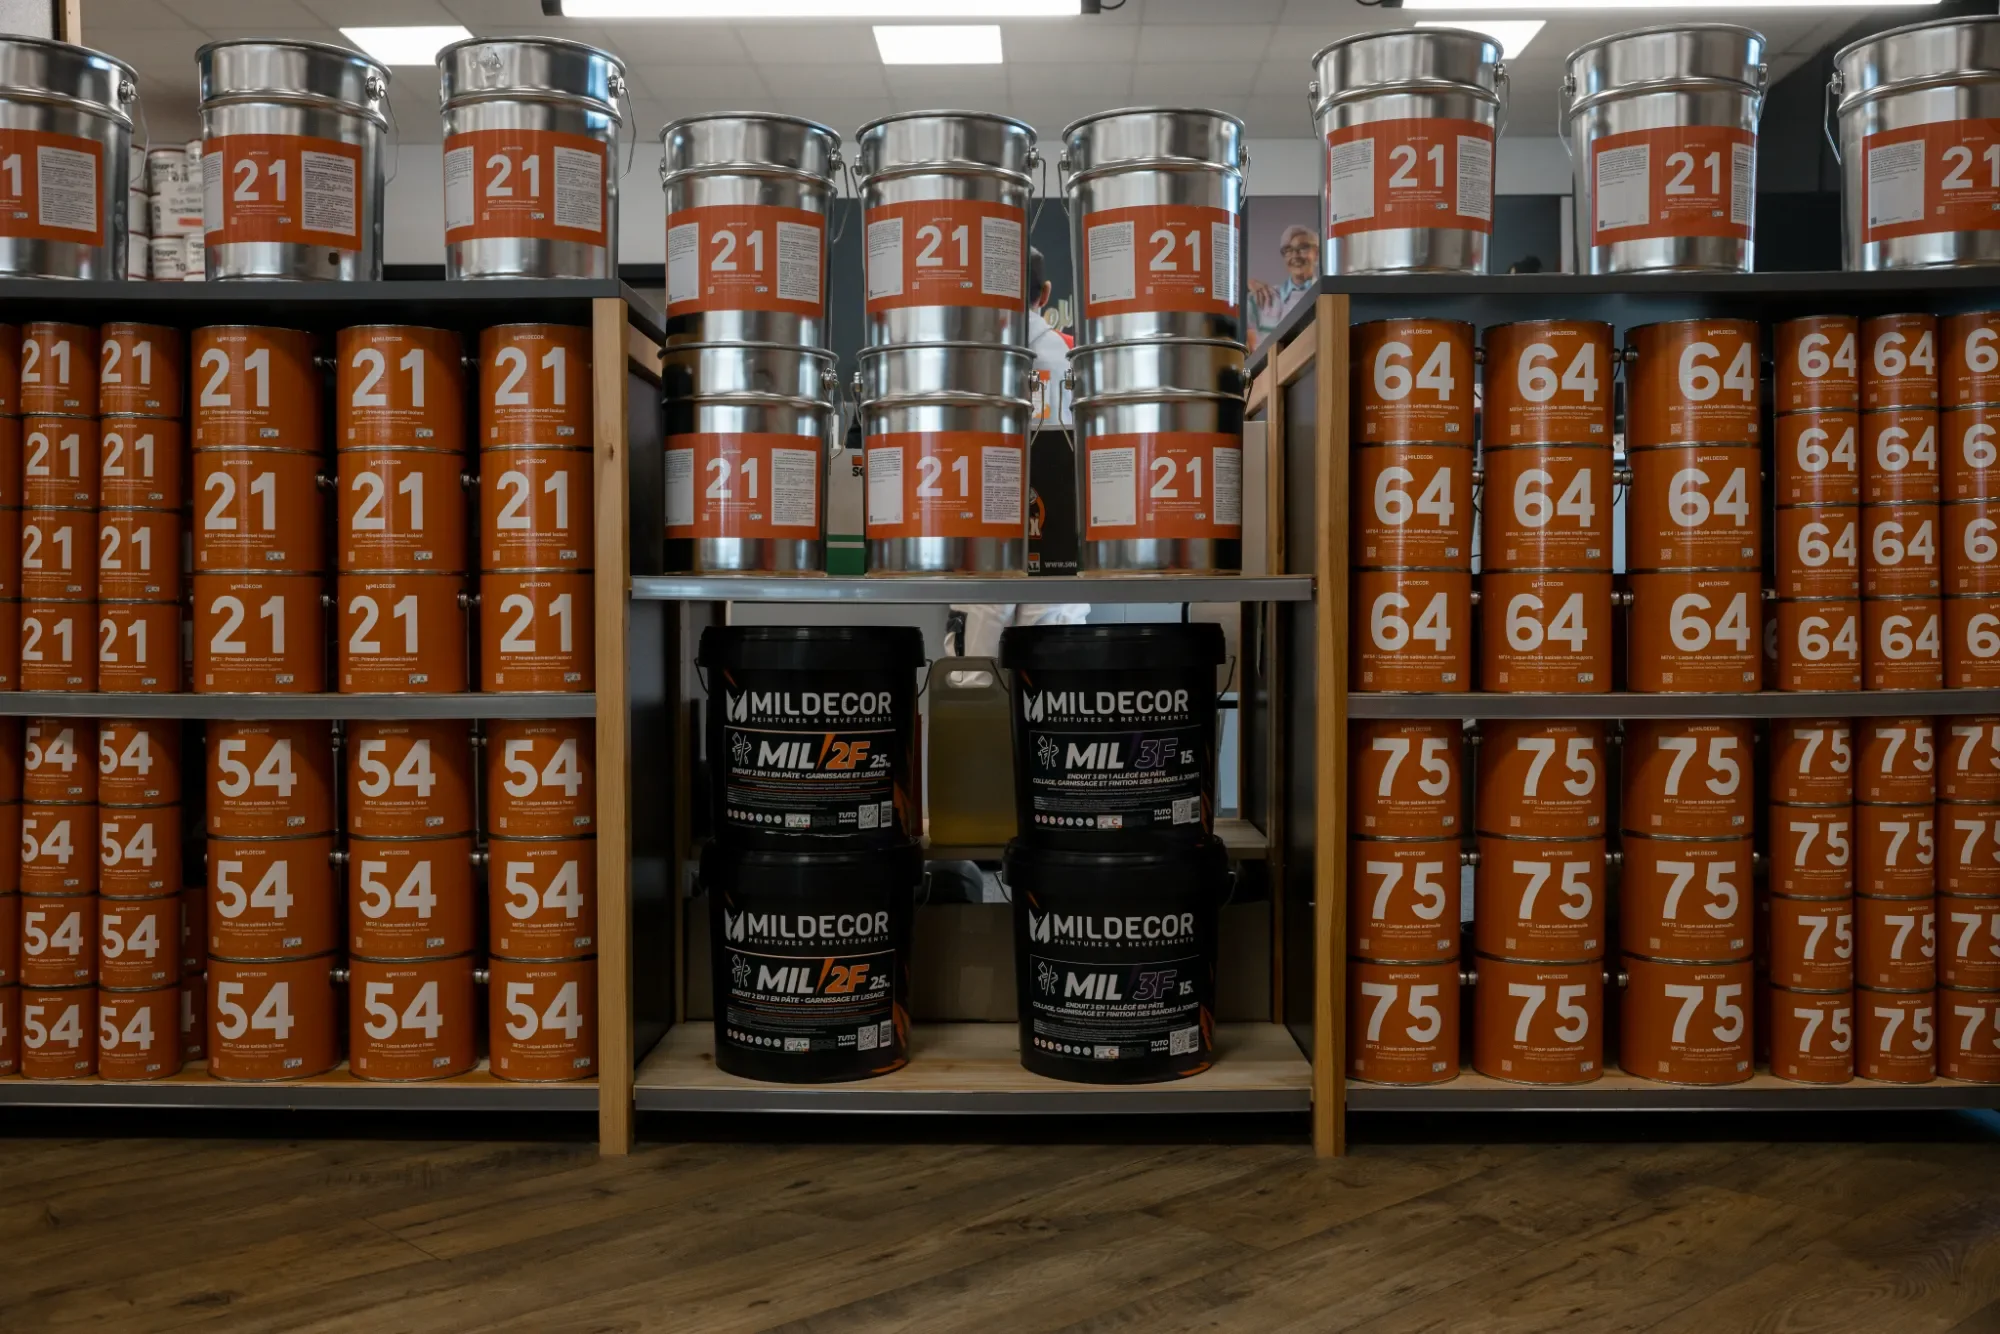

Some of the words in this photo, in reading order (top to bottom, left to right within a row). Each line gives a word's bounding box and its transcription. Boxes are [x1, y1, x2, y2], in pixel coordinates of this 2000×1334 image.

[234, 159, 286, 201] 21
[486, 154, 539, 196] 21
[1389, 144, 1444, 188] 21
[1665, 152, 1720, 195] 21
[1941, 144, 2000, 189] 21
[711, 230, 763, 271] 21
[916, 225, 968, 267] 21
[1149, 229, 1200, 271] 21
[22, 339, 69, 383] 21
[102, 340, 151, 384] 21
[1374, 341, 1454, 401] 64
[1517, 343, 1598, 401] 64
[1678, 342, 1754, 401] 64
[1798, 333, 1856, 378] 64
[1874, 331, 1934, 376] 64
[201, 349, 269, 406] 21
[353, 348, 424, 407] 21
[496, 347, 565, 405] 21
[27, 433, 79, 476] 21
[104, 433, 153, 476] 21
[1797, 428, 1856, 472] 64
[1877, 426, 1936, 471] 64
[705, 457, 758, 498] 21
[916, 456, 968, 496] 21
[1150, 457, 1201, 497] 21
[1374, 467, 1454, 526] 64
[1514, 468, 1595, 527] 64
[1668, 468, 1749, 527] 64
[205, 472, 275, 529] 21
[496, 471, 568, 529] 21
[1873, 520, 1934, 564] 64
[23, 618, 72, 660] 21
[100, 620, 146, 662] 21
[211, 596, 284, 653] 21
[349, 596, 417, 653] 21
[501, 594, 571, 652] 21
[1370, 592, 1451, 651] 64
[1506, 593, 1587, 651] 64
[1670, 593, 1750, 651] 64
[1799, 616, 1857, 660] 64
[751, 692, 892, 715] MILDECOR
[1047, 689, 1189, 715] MILDECOR
[25, 728, 77, 771] 54
[218, 740, 296, 796] 54
[360, 740, 435, 796] 54
[504, 740, 582, 797] 54
[757, 740, 816, 769] MIL
[825, 741, 871, 770] 2F
[1065, 742, 1124, 770] MIL
[1134, 737, 1179, 769] 3F
[1373, 738, 1449, 796] 75
[1518, 738, 1594, 796] 75
[1659, 738, 1739, 795] 75
[1876, 728, 1932, 772] 75
[732, 766, 751, 775] ENDUIT
[781, 770, 800, 779] PÂTE
[805, 771, 851, 779] GARNISSAGE
[861, 769, 886, 777] LISSAGE
[1032, 777, 1056, 786] COLLAGE,
[1112, 771, 1139, 779] ALLÉGÉ
[1150, 770, 1166, 778] PÂTE
[102, 824, 156, 865] 54
[1791, 823, 1848, 865] 75
[217, 861, 293, 918] 54
[360, 861, 436, 918] 54
[505, 861, 583, 919] 54
[1368, 862, 1445, 919] 75
[1514, 861, 1592, 919] 75
[1657, 861, 1738, 919] 75
[25, 912, 82, 955] 54
[103, 915, 159, 958] 54
[748, 911, 889, 939] MILDECOR
[748, 937, 803, 946] PEINTURES
[1054, 912, 1194, 940] MILDECOR
[1054, 938, 1109, 947] PEINTURES
[1799, 916, 1852, 959] 75
[731, 988, 751, 997] ENDUIT
[770, 995, 780, 1003] EN
[781, 995, 800, 1003] PÂTE
[805, 995, 850, 1004] GARNISSAGE
[851, 994, 860, 1002] ET
[861, 991, 885, 1001] LISSAGE
[757, 964, 814, 994] MIL
[824, 963, 870, 994] 2F
[1064, 971, 1123, 1001] MIL
[1132, 969, 1178, 1001] 3F
[25, 1006, 82, 1048] 54
[101, 1007, 153, 1048] 54
[217, 982, 293, 1039] 54
[365, 982, 442, 1039] 54
[506, 982, 582, 1039] 54
[1032, 1001, 1055, 1012] COLLAGE,
[1056, 1007, 1096, 1017] GARNISSAGE
[1151, 1007, 1176, 1016] BANDES
[1065, 1002, 1089, 1010] ENDUIT
[1149, 1001, 1164, 1009] PÂTE
[1362, 983, 1440, 1042] 75
[1509, 984, 1588, 1042] 75
[1666, 985, 1743, 1042] 75
[837, 1034, 856, 1042] TUTO
[1150, 1039, 1169, 1047] TUTO
[1795, 1008, 1850, 1051] 75
[1875, 1008, 1933, 1050] 75
